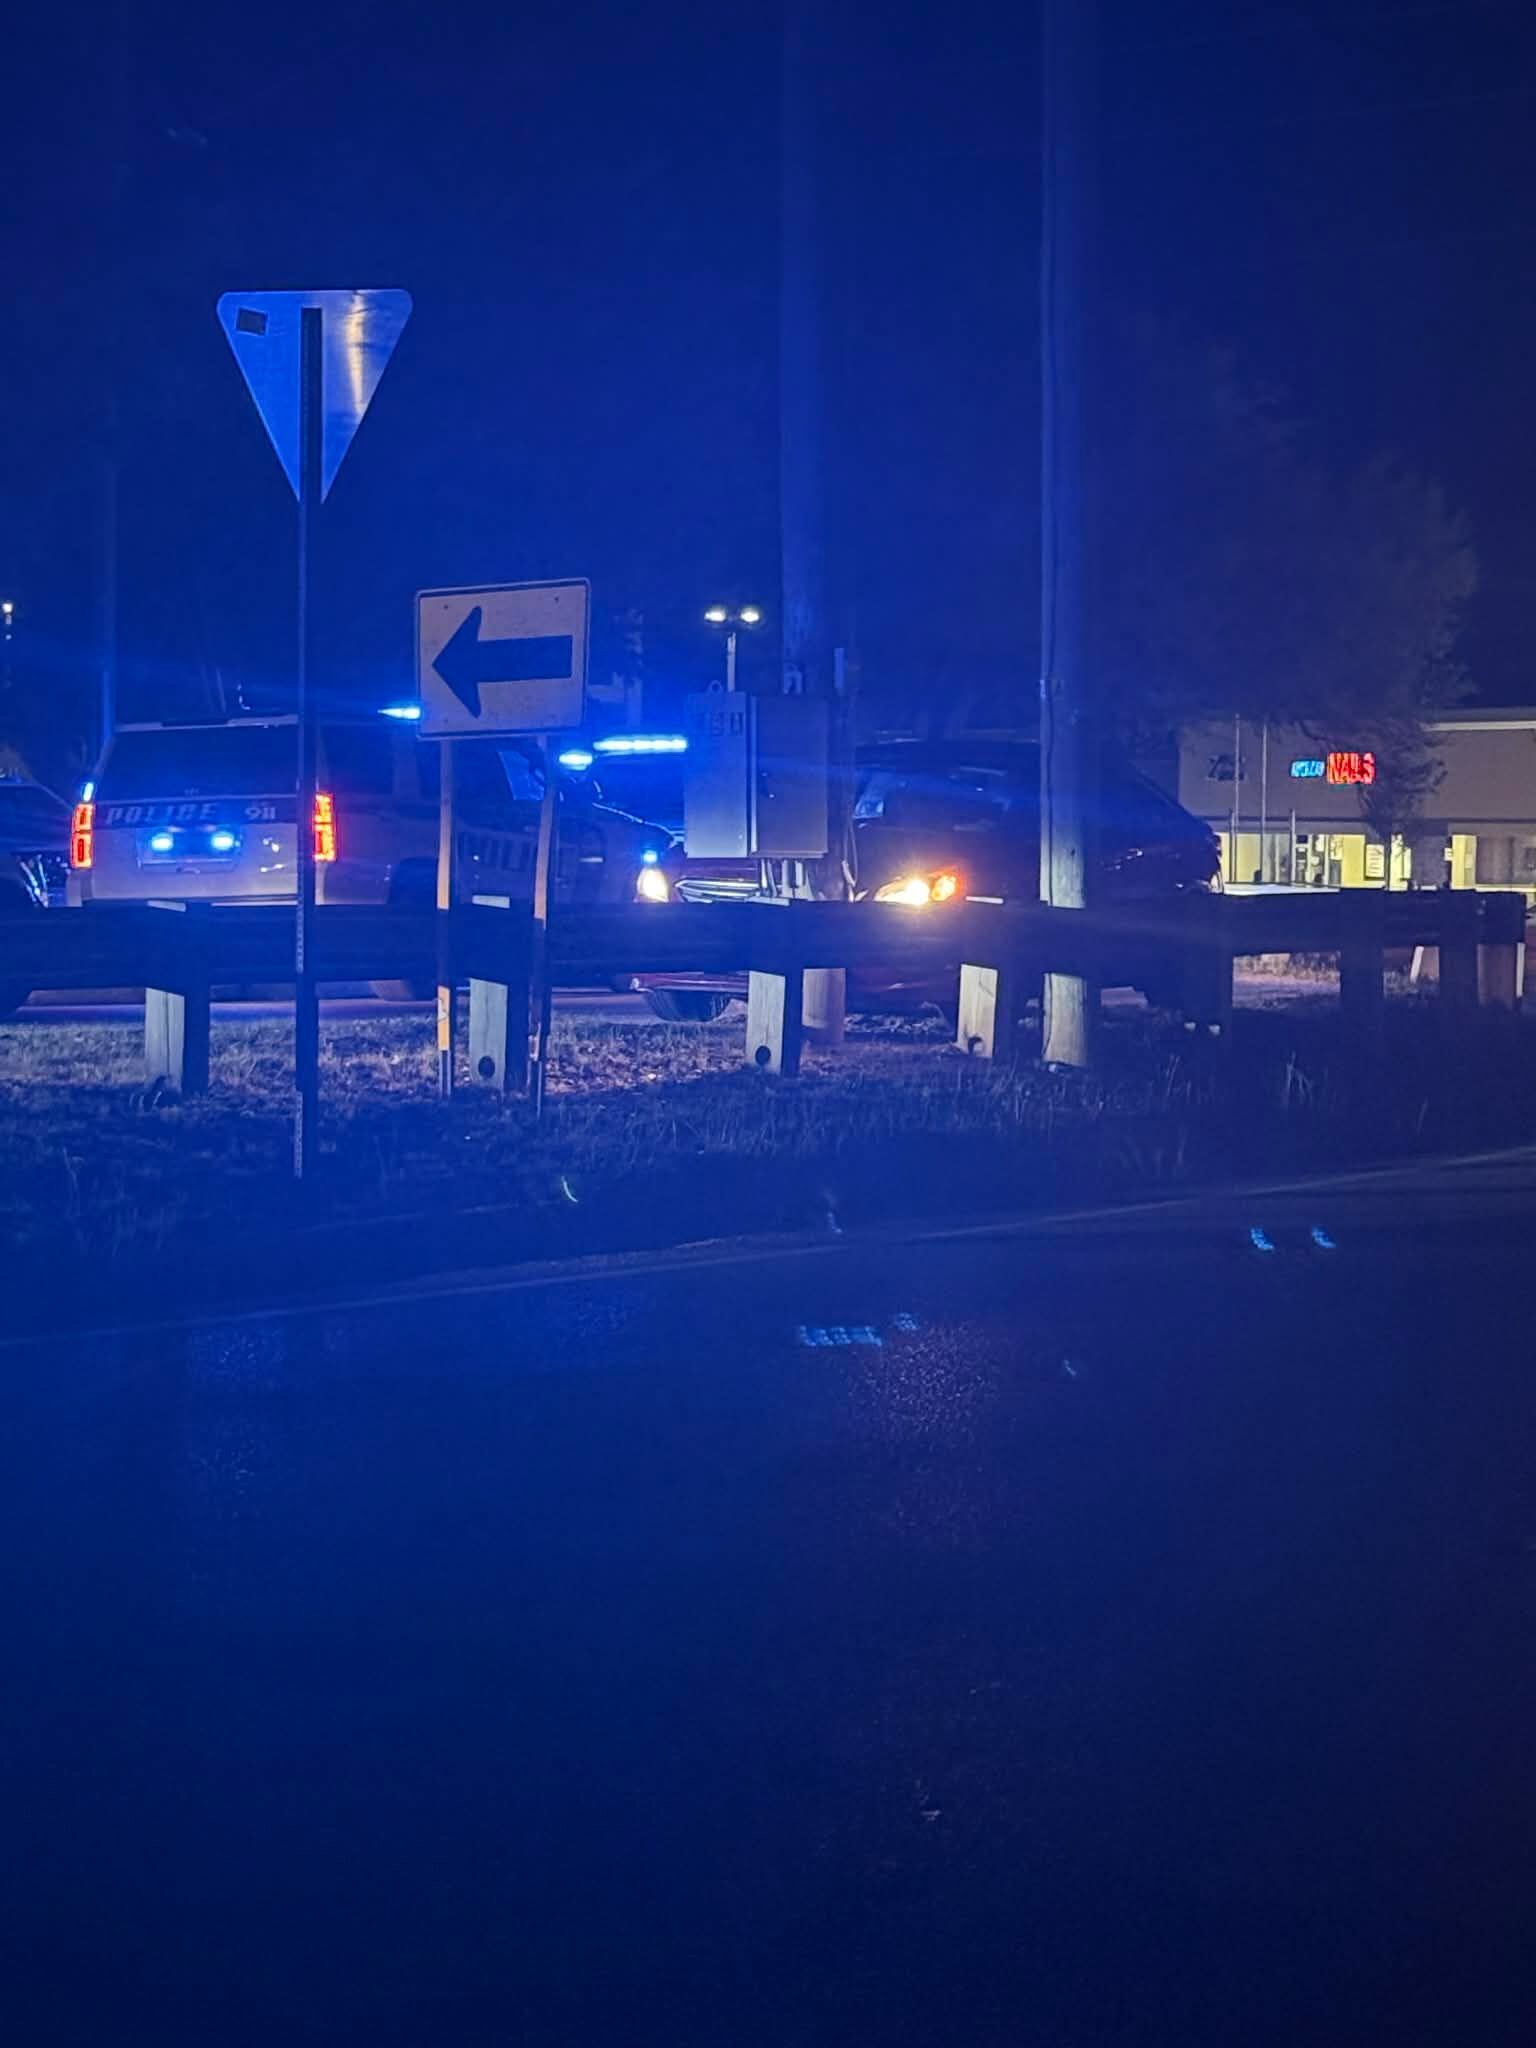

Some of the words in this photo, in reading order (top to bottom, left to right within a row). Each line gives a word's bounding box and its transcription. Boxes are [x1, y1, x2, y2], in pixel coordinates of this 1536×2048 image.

[1327, 752, 1376, 785] NAILS
[106, 804, 218, 824] POLICE
[244, 807, 276, 821] 911
